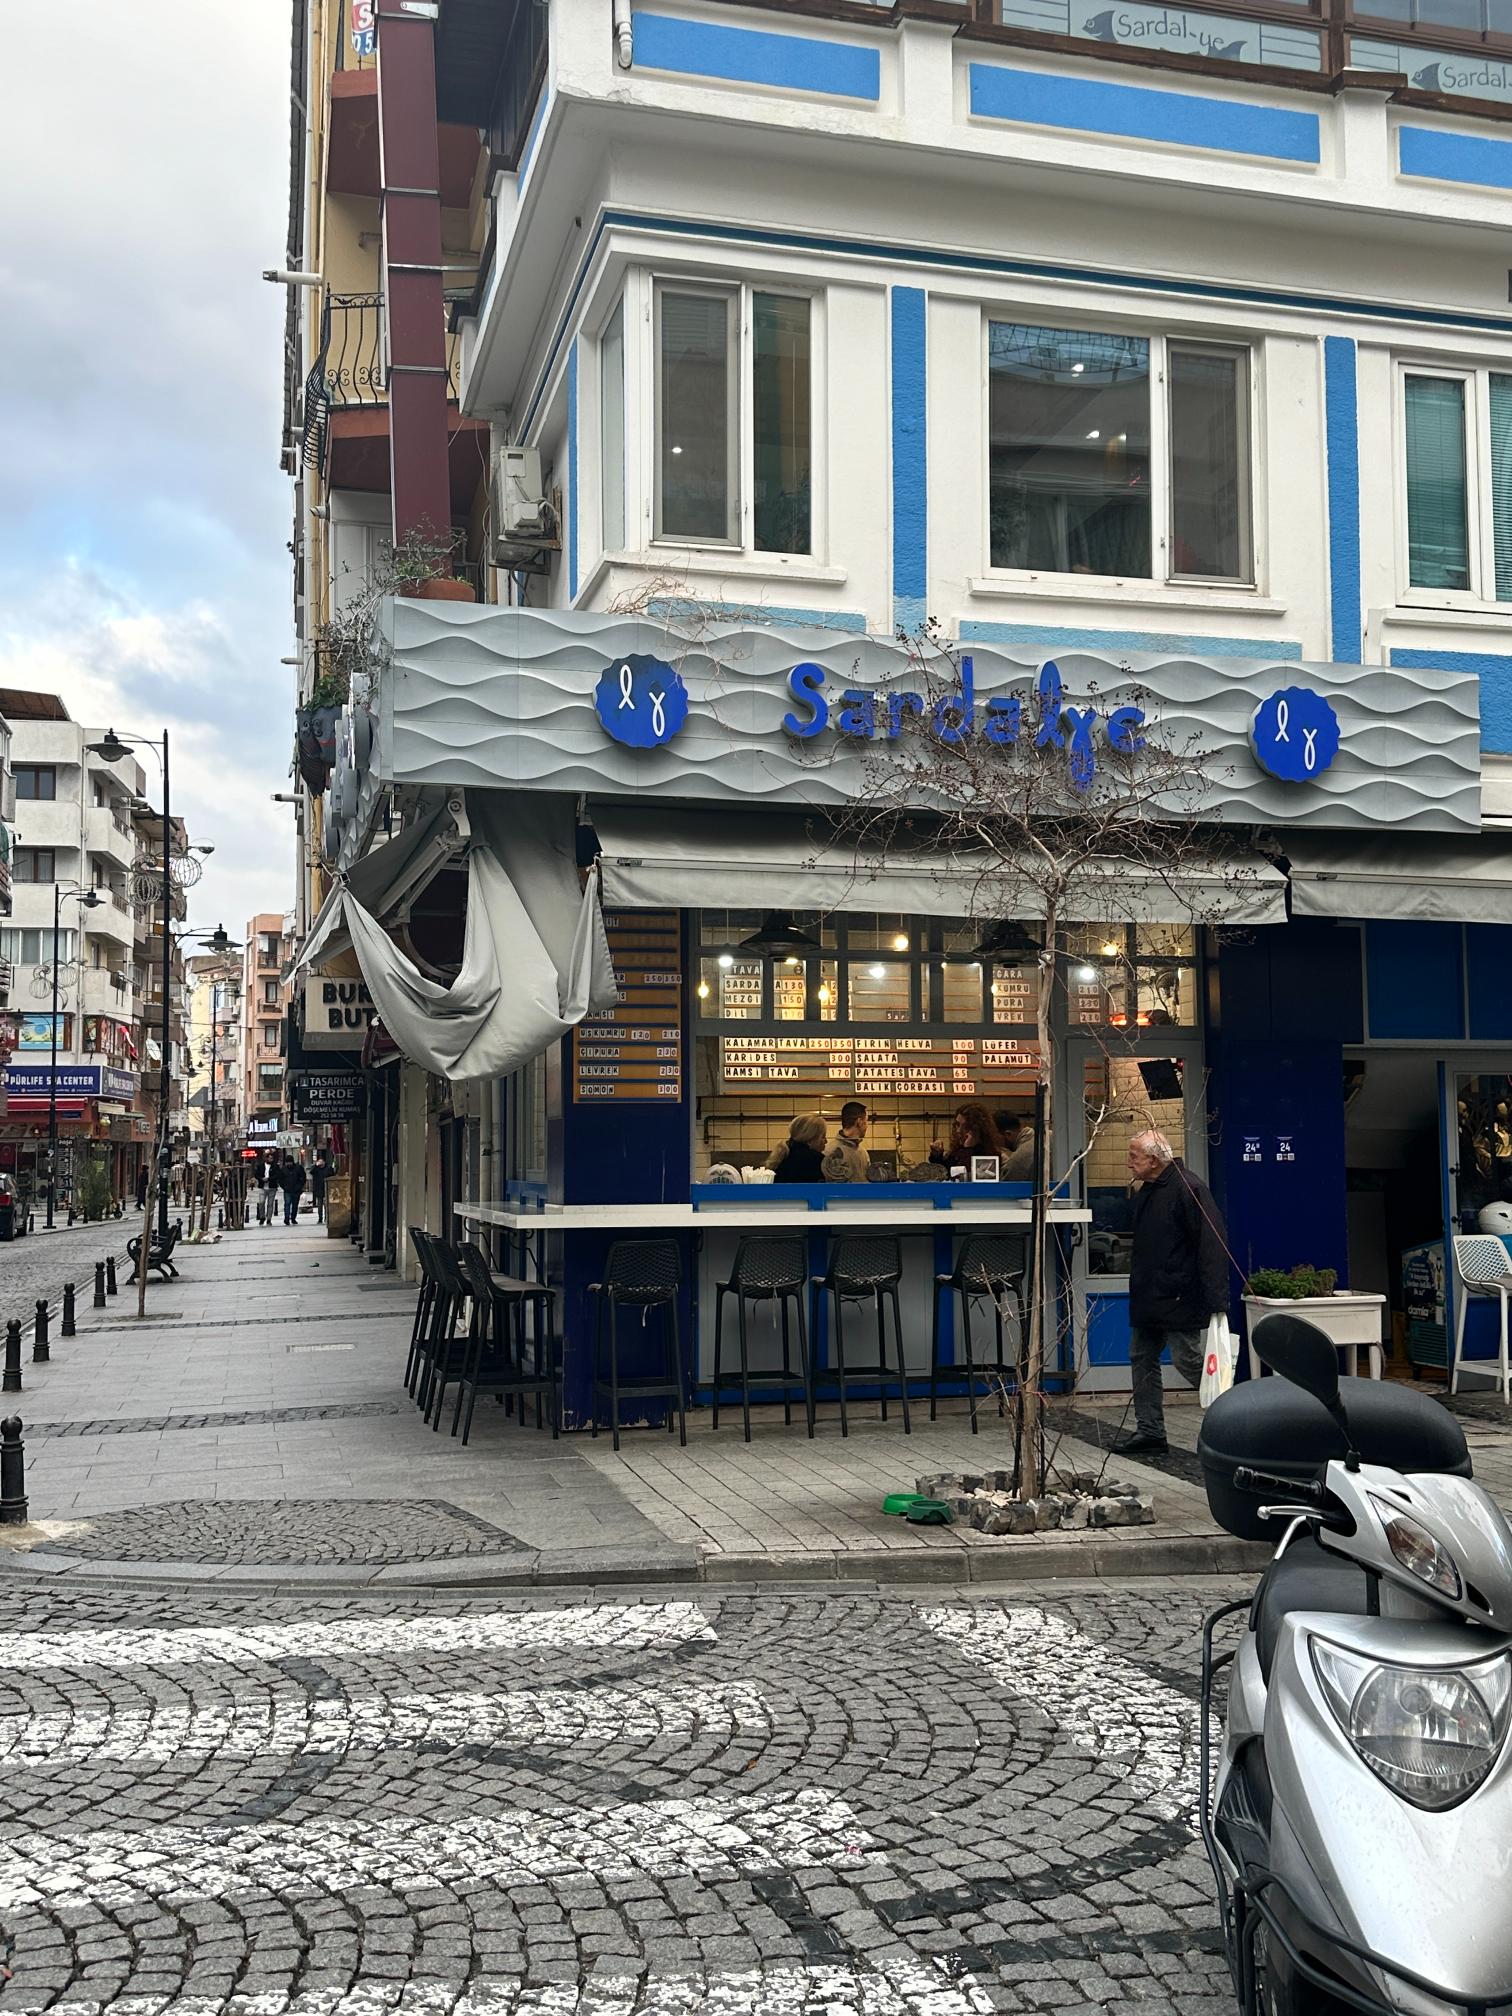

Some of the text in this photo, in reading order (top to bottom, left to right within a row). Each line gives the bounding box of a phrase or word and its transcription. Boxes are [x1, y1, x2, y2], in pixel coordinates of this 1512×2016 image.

[580, 1029, 626, 1037] USKUMRU
[725, 1039, 852, 1048] KALAMAR TAVA 250 350
[857, 1040, 973, 1049] FIRIN HELVA 100
[830, 1053, 851, 1062] 300
[857, 1053, 966, 1063] SALATA 90
[984, 1054, 1031, 1064] PALAMUT
[580, 1066, 619, 1075] LEVREK
[770, 1068, 798, 1077] TAVA
[830, 1068, 850, 1077] 170
[857, 1068, 967, 1078] PATATES TAVA 65
[63, 1076, 94, 1086] CENTER
[580, 1085, 614, 1094] SOMON
[857, 1082, 890, 1091] BALIK
[955, 1084, 974, 1092] 100
[309, 1088, 355, 1099] PERDE
[1280, 1142, 1291, 1152] 24
